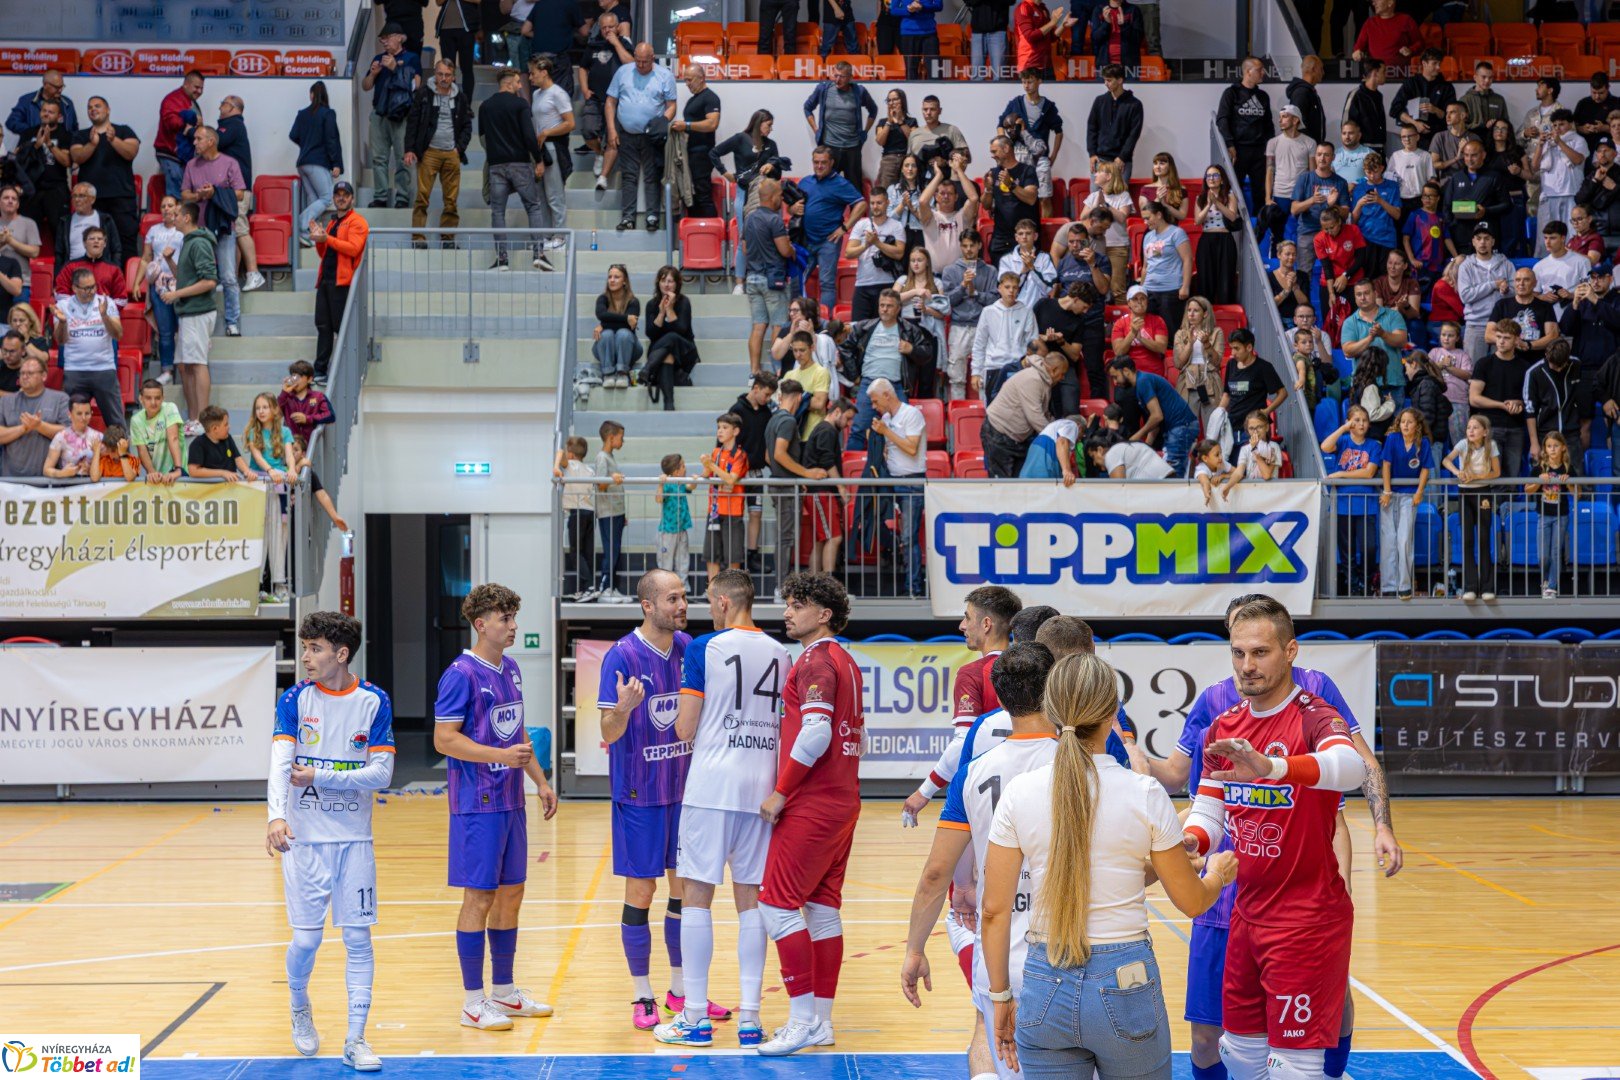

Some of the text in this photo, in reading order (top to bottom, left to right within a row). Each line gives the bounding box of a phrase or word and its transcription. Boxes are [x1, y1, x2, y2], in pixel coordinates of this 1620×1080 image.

[23, 52, 58, 62] Holding
[101, 56, 126, 70] BH
[139, 53, 194, 63] Bige Holding
[237, 57, 263, 71] BH
[274, 55, 330, 65] Bige Holding
[149, 63, 184, 73] Csoport
[284, 65, 320, 75] Csoport
[0, 495, 239, 526] ezettudatosan
[125, 534, 250, 570] élsportért
[724, 654, 781, 713] 14
[1, 700, 243, 732] NYÍREGYHÁZA
[496, 708, 516, 723] MOL
[0, 734, 245, 750] MEGYEI JOGÚ VÁROS ÖNKORMÁNYZATA
[299, 800, 360, 812] STUDIO
[1233, 838, 1281, 858] TUDIO
[357, 886, 373, 910] 11
[1275, 993, 1312, 1024] 78
[1282, 1029, 1306, 1038] JAKO
